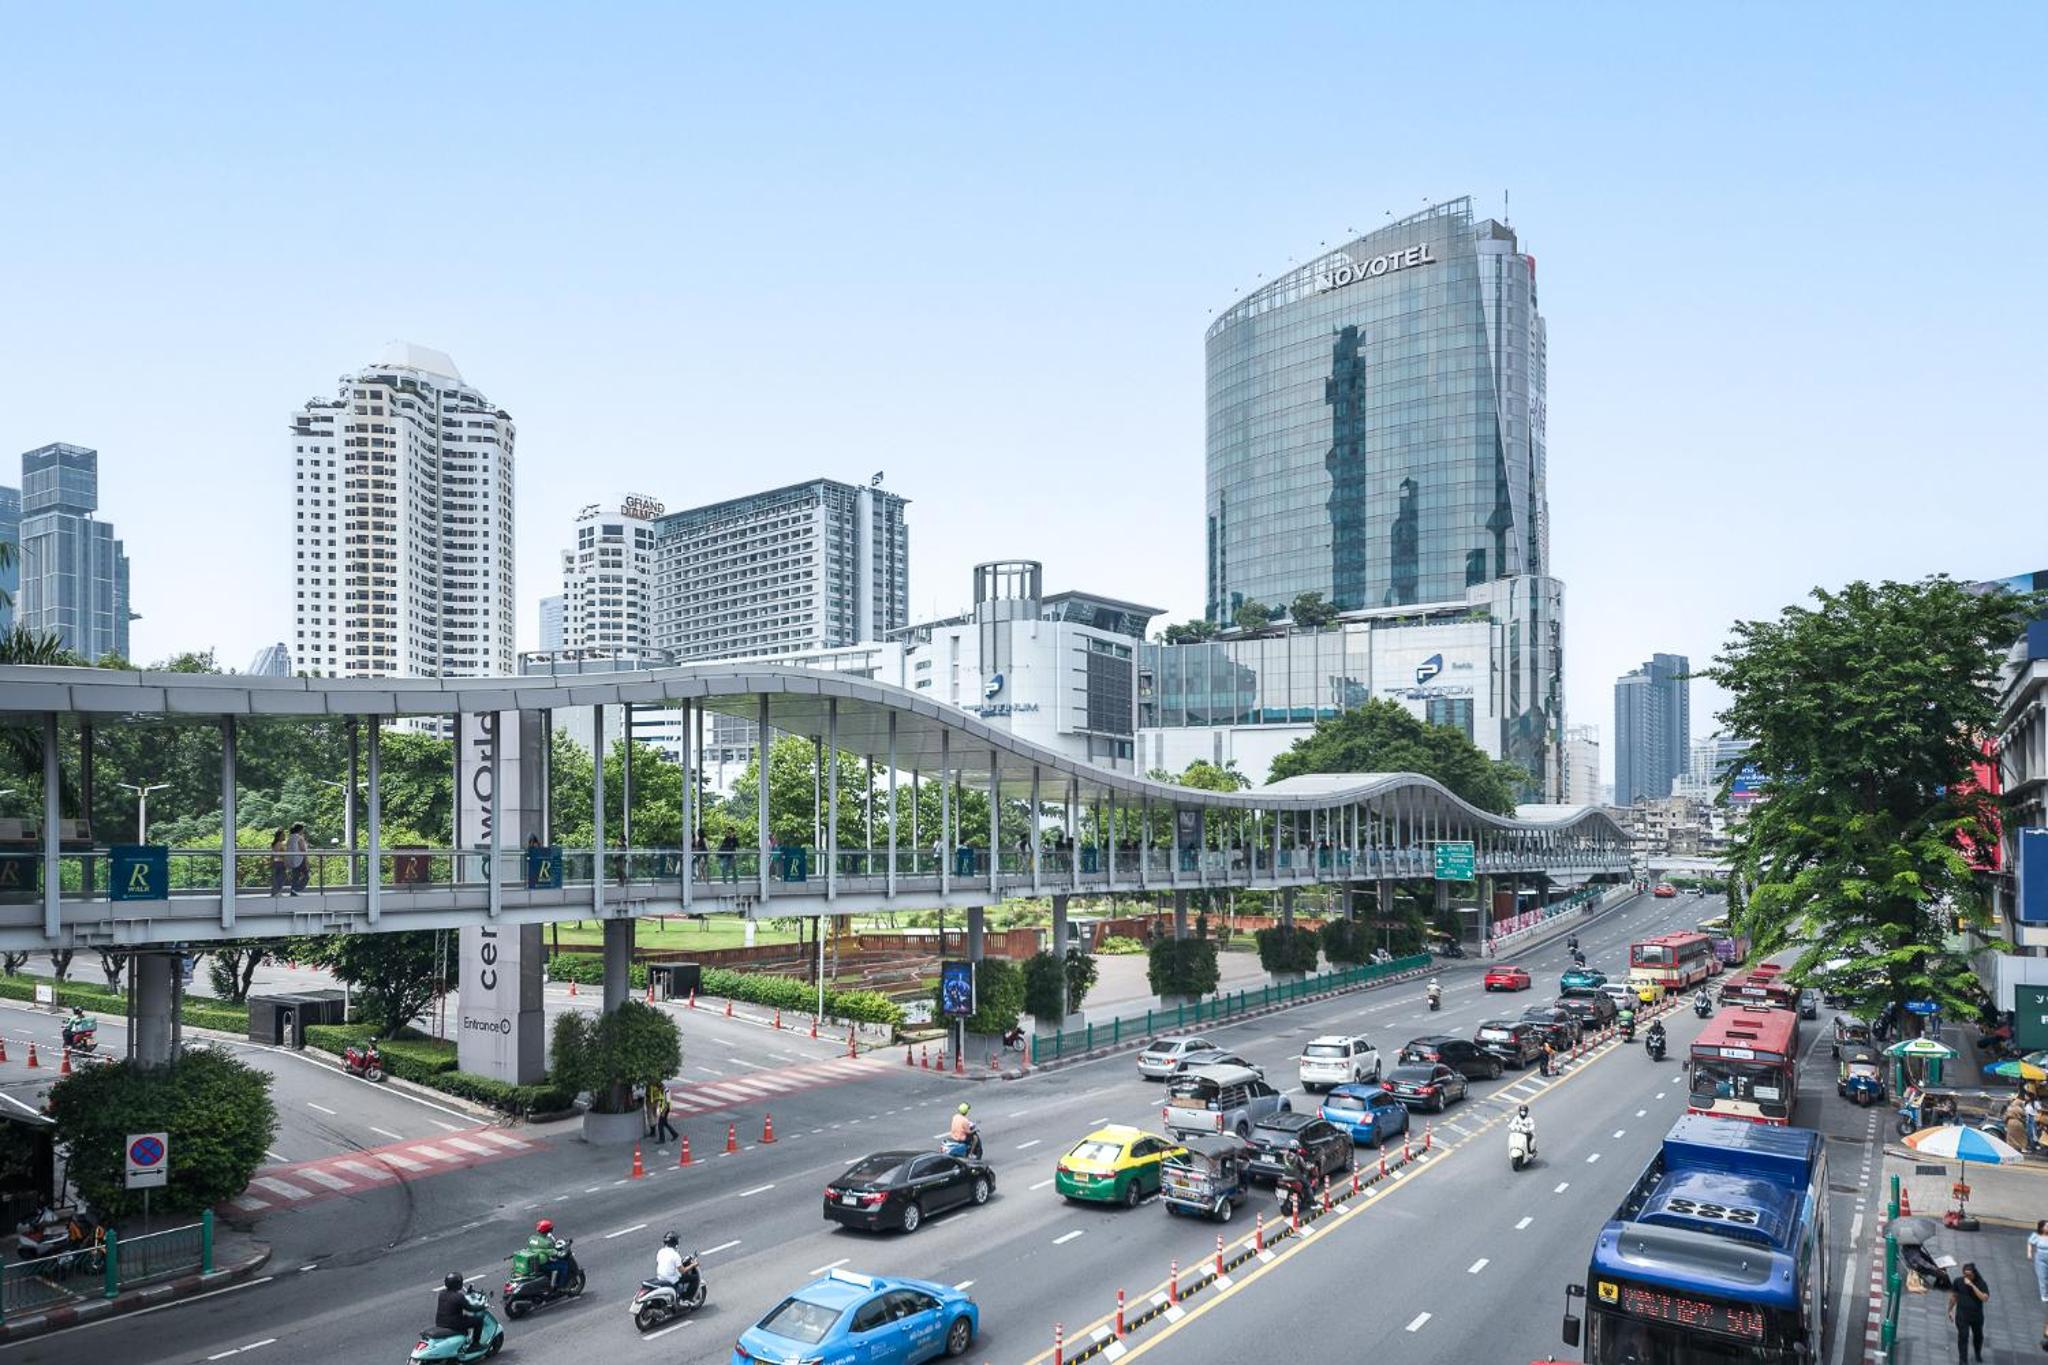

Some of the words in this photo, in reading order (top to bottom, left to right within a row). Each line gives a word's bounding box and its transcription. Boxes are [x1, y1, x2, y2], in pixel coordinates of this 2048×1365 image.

[1316, 242, 1435, 293] NOVOTEL
[625, 496, 665, 514] GRAND
[129, 863, 150, 887] R
[463, 1016, 499, 1033] Entrance
